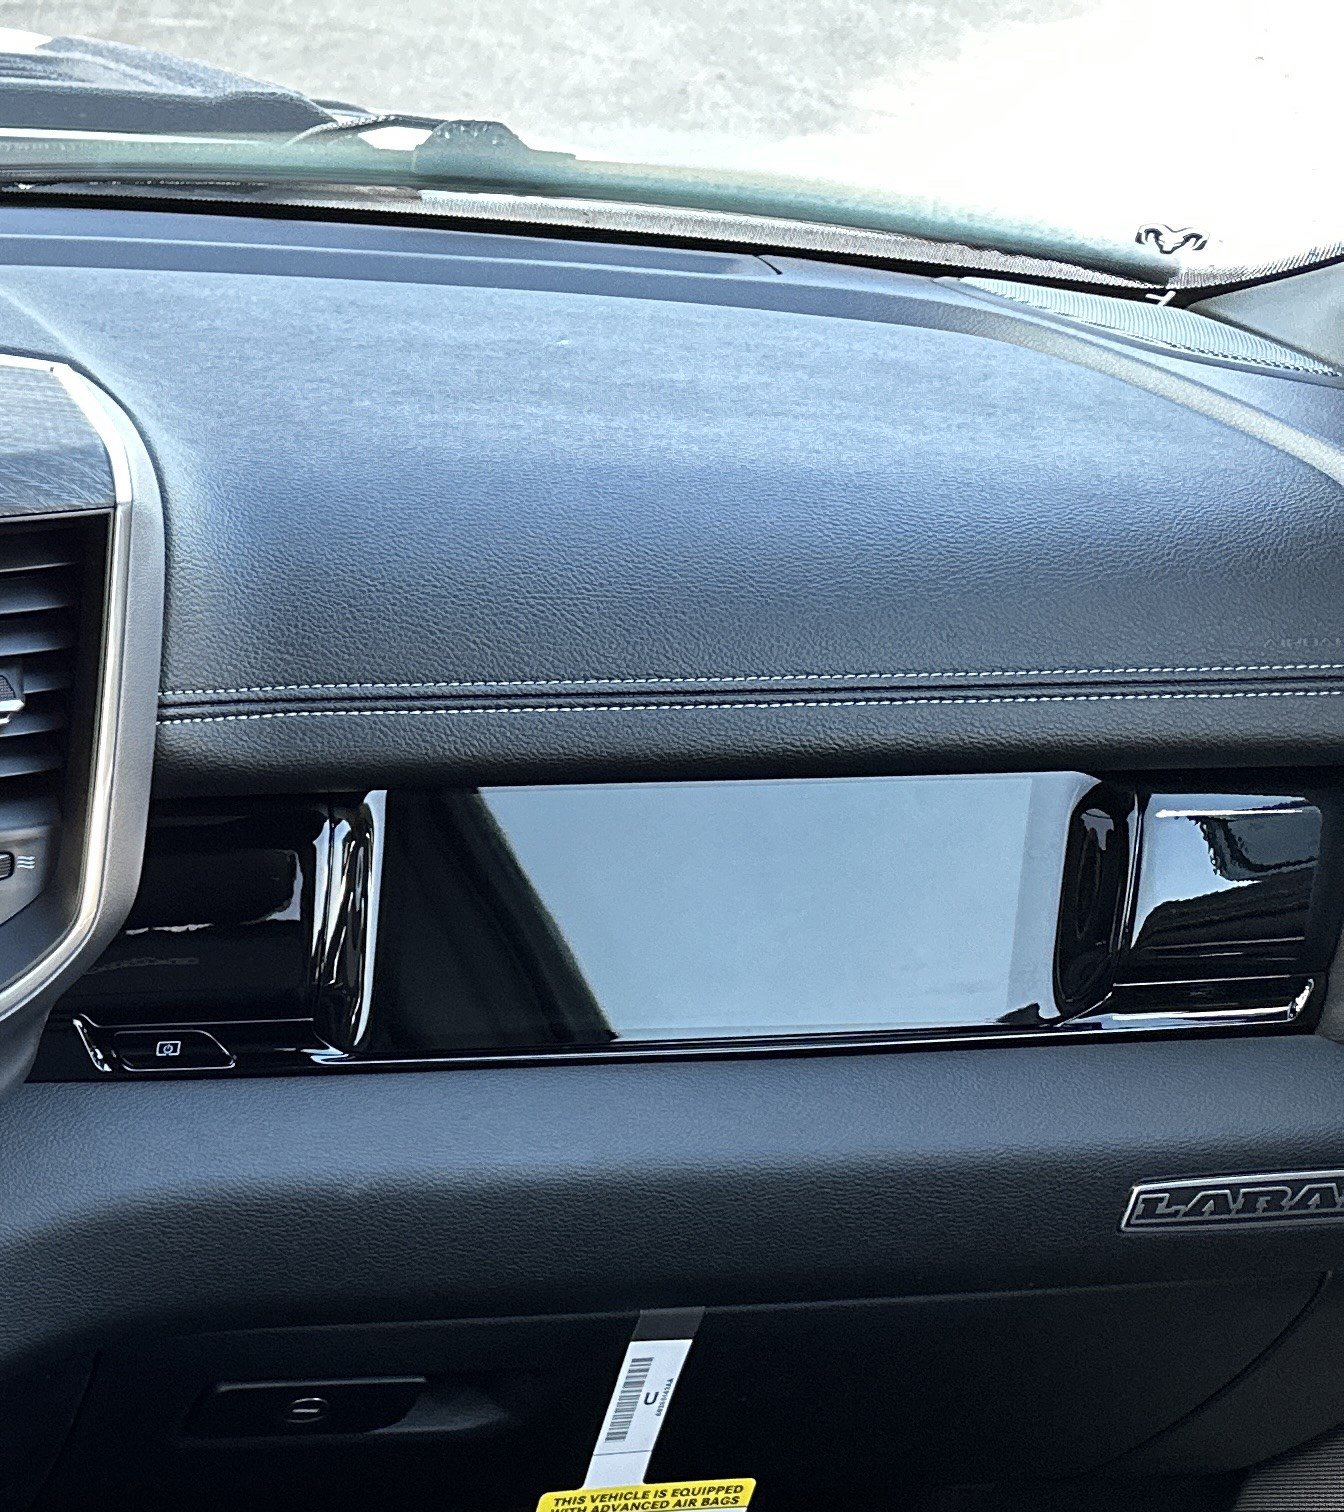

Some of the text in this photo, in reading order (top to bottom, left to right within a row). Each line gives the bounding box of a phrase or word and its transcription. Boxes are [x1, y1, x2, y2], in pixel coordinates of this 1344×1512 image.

[1130, 1183, 1344, 1225] LARA
[553, 1485, 744, 1507] THIS VEHICLE IS EQUIPPED
[672, 1498, 698, 1508] AIR
[701, 1496, 740, 1506] BAGS
